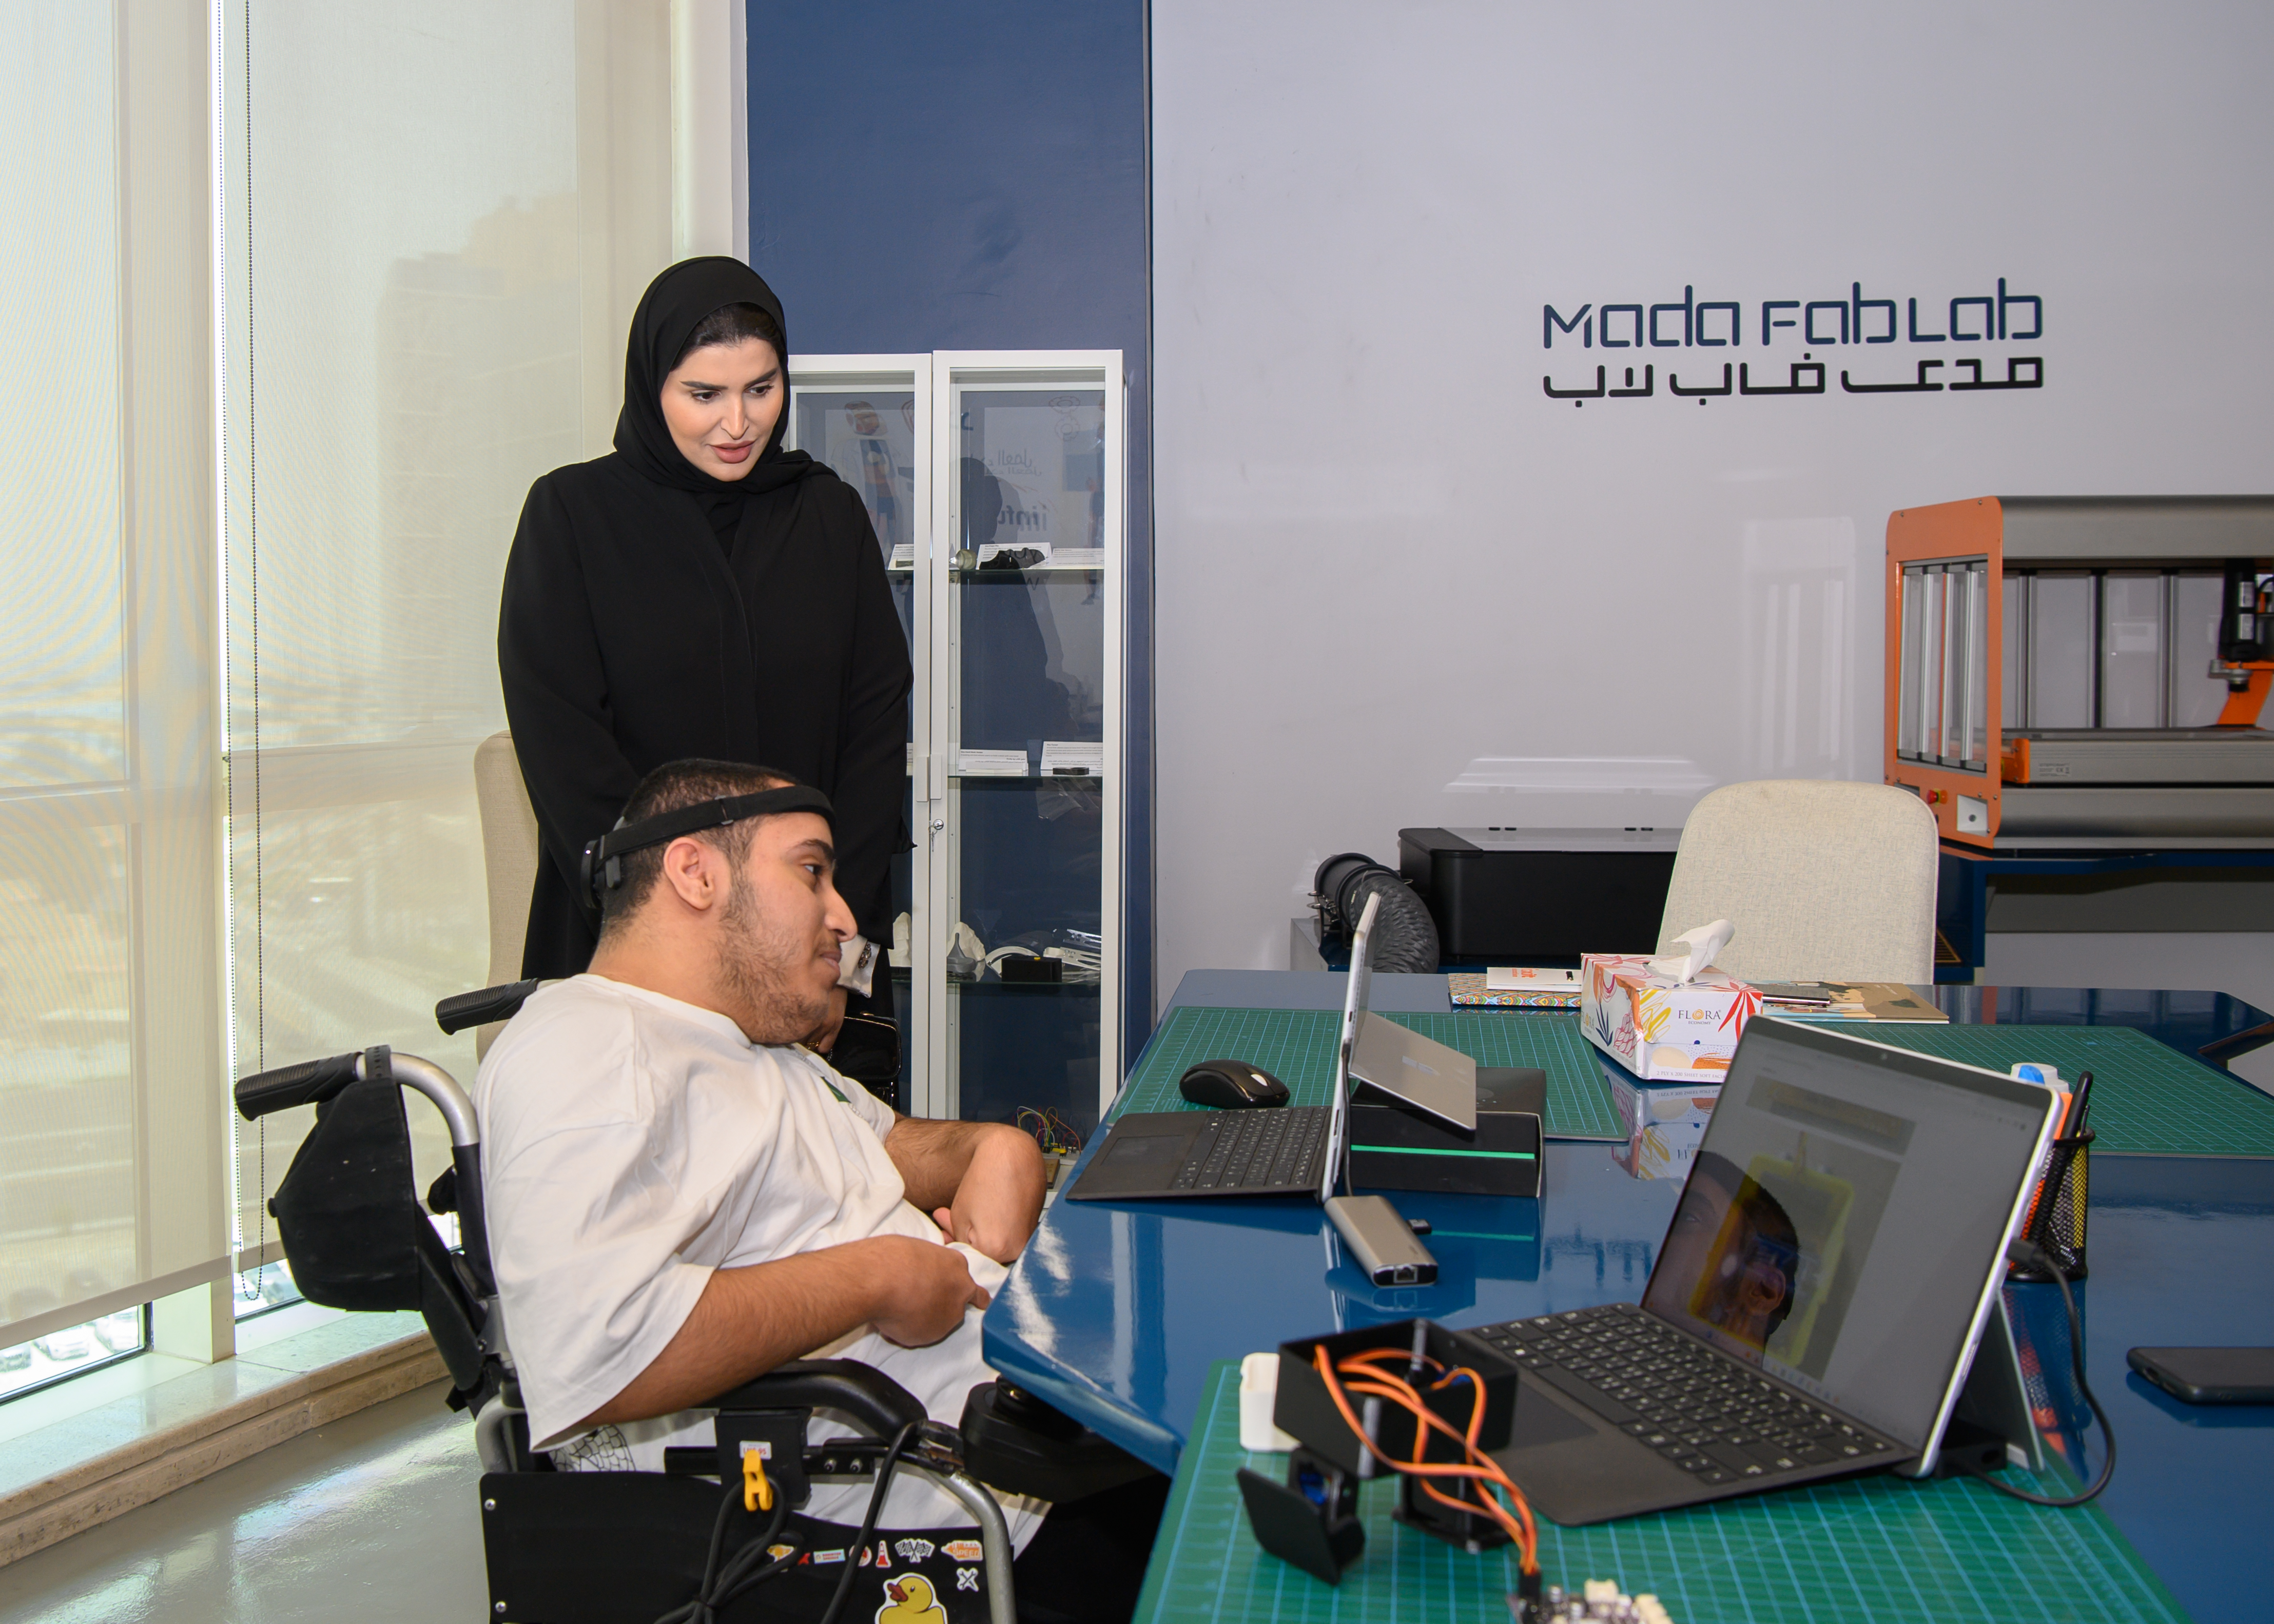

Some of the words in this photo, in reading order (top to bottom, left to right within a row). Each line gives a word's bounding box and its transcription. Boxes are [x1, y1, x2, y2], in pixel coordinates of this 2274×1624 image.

[1544, 285, 1740, 349] Mada
[1543, 364, 1654, 408] لاب
[1669, 353, 1825, 406] فاب
[1678, 1009, 1721, 1020] FLORA
